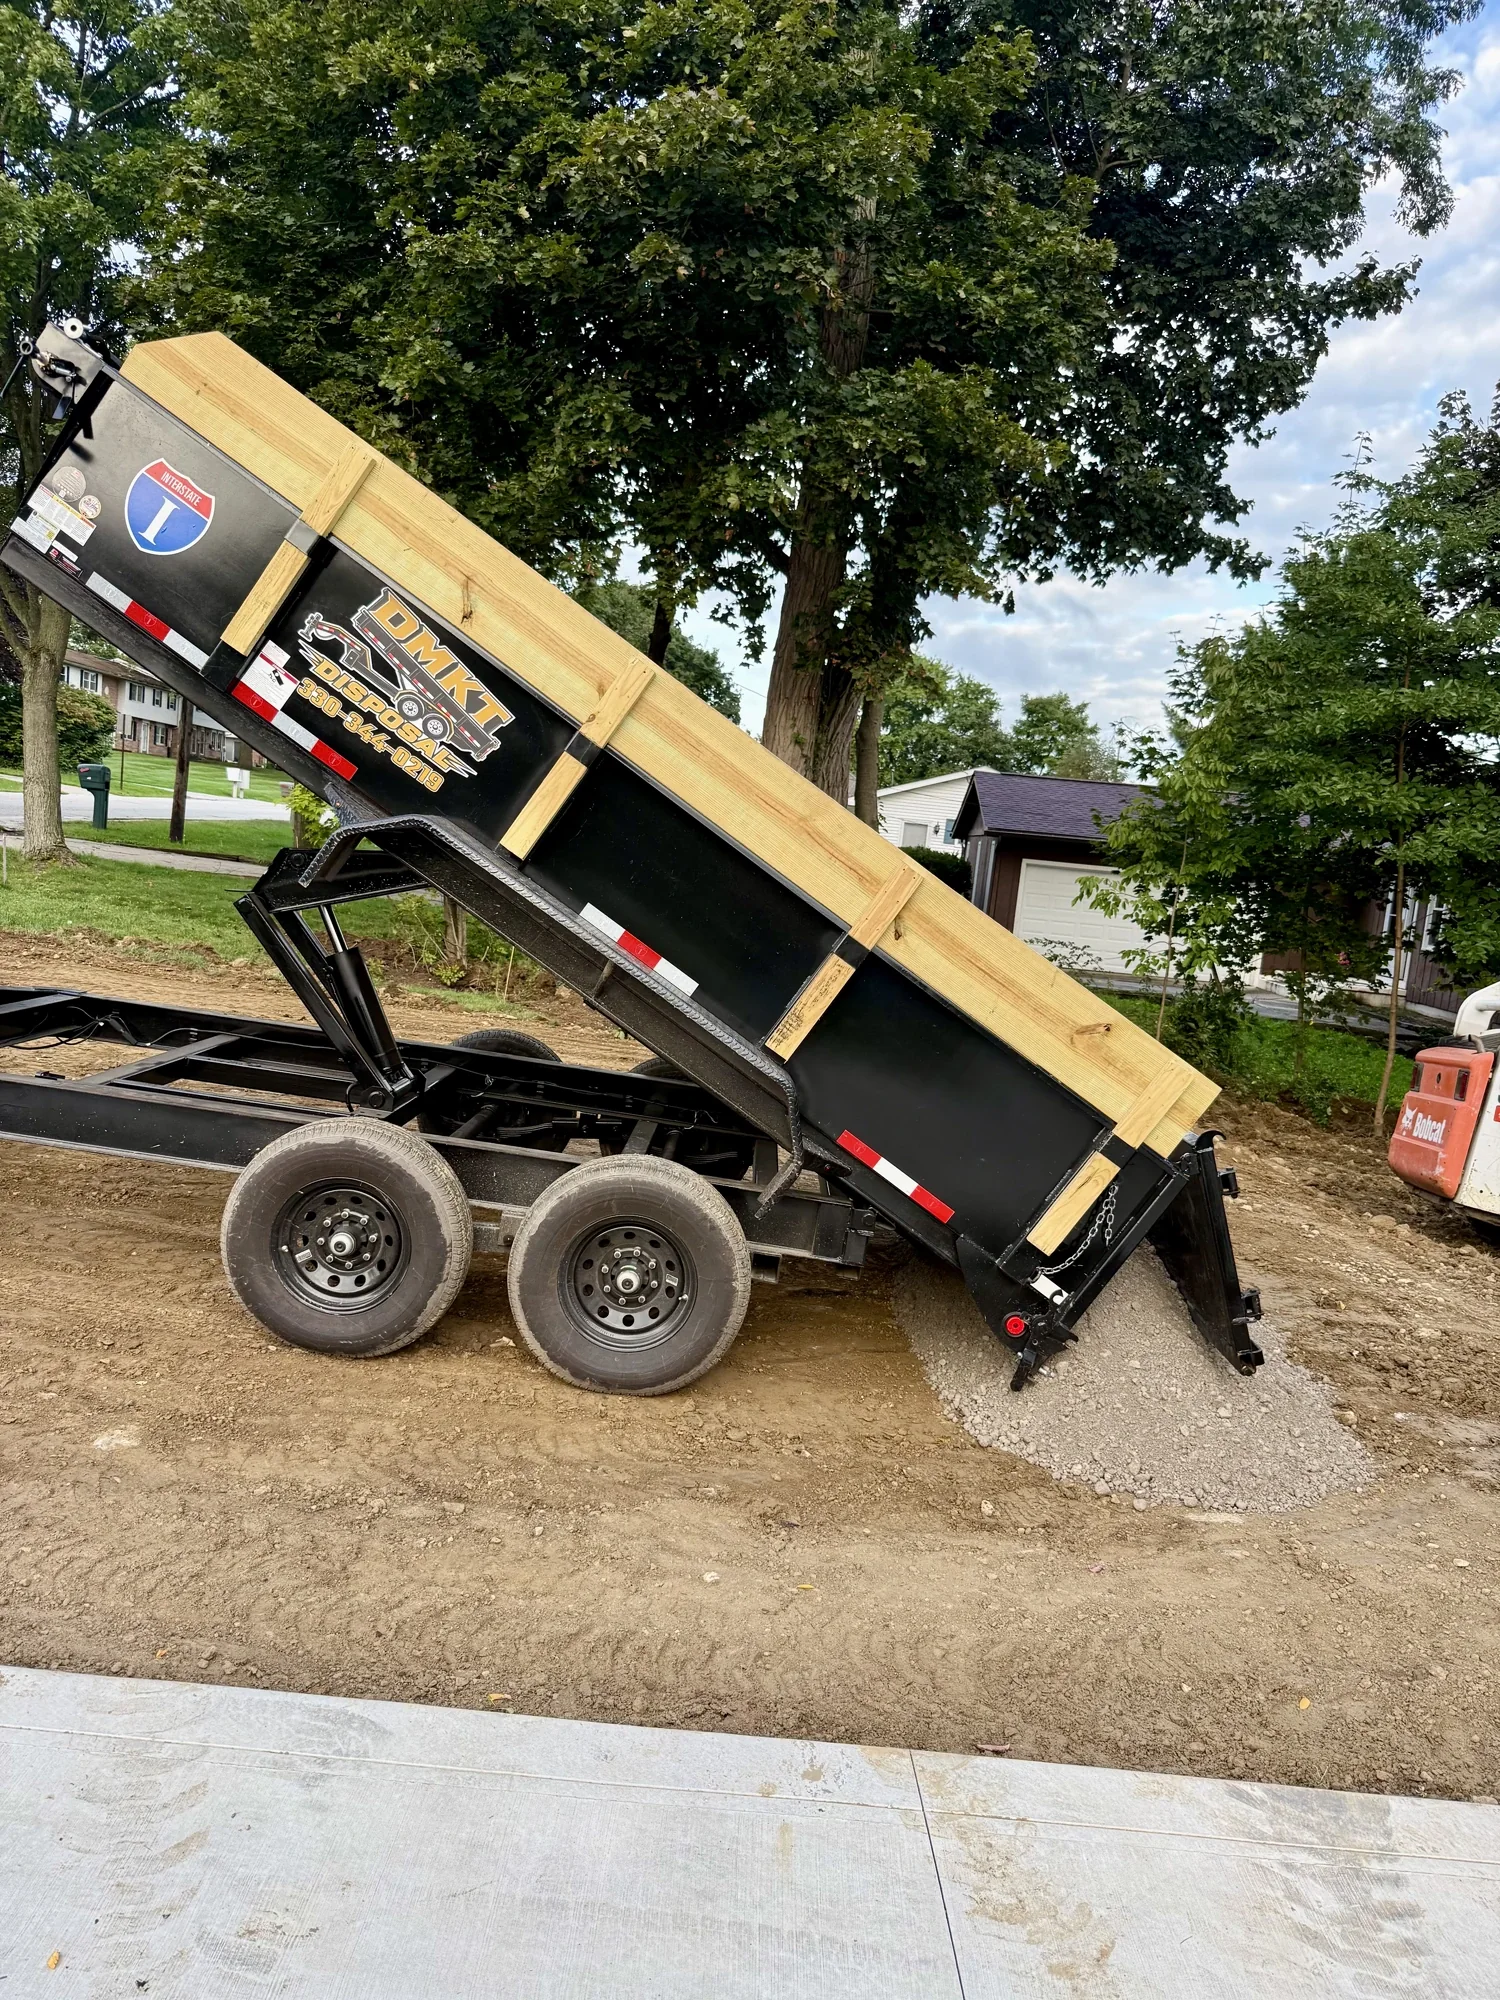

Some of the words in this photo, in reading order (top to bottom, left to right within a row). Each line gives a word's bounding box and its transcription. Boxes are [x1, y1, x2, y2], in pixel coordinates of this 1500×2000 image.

[138, 495, 180, 546] I
[161, 471, 202, 507] INTERSTATE
[371, 592, 512, 728] DMKT
[296, 677, 445, 793] 330-344-0219
[313, 657, 457, 770] DISPOSAL
[1412, 1112, 1446, 1144] Bobcat
